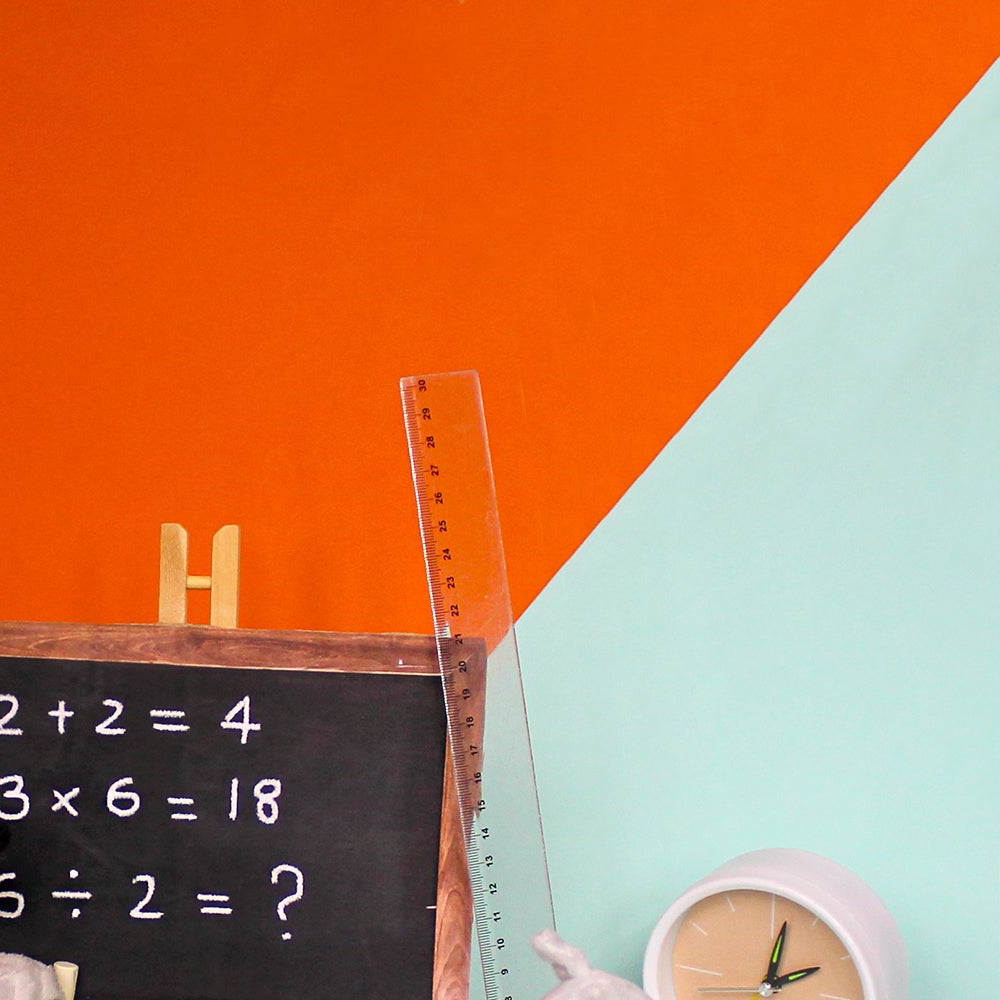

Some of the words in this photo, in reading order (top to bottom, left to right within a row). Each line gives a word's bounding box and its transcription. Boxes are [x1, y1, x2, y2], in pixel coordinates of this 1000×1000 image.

[418, 380, 426, 391] 30
[422, 408, 431, 420] 29
[426, 436, 435, 448] 28
[431, 465, 439, 476] 27
[435, 492, 443, 504] 26
[439, 520, 447, 532] 25
[443, 548, 451, 560] 24
[447, 577, 455, 588] 23
[450, 604, 459, 616] 22
[455, 634, 463, 644] 21
[459, 661, 467, 672] 20
[462, 689, 471, 700] 19
[48, 700, 74, 735] +
[95, 699, 126, 736] 2
[149, 709, 190, 732] =
[220, 695, 261, 744] 4
[466, 716, 474, 728] 18
[470, 745, 478, 756] 17
[474, 772, 482, 783] 16
[107, 777, 141, 817] 6
[167, 797, 198, 820] =
[228, 777, 282, 824] 18
[478, 800, 486, 811] 15
[482, 828, 490, 839] 14
[485, 856, 494, 867] 13
[489, 883, 497, 894] 12
[129, 874, 164, 919] 2
[197, 893, 233, 915] =
[271, 863, 304, 940] ?
[494, 911, 501, 922] 11
[497, 938, 505, 950] 10
